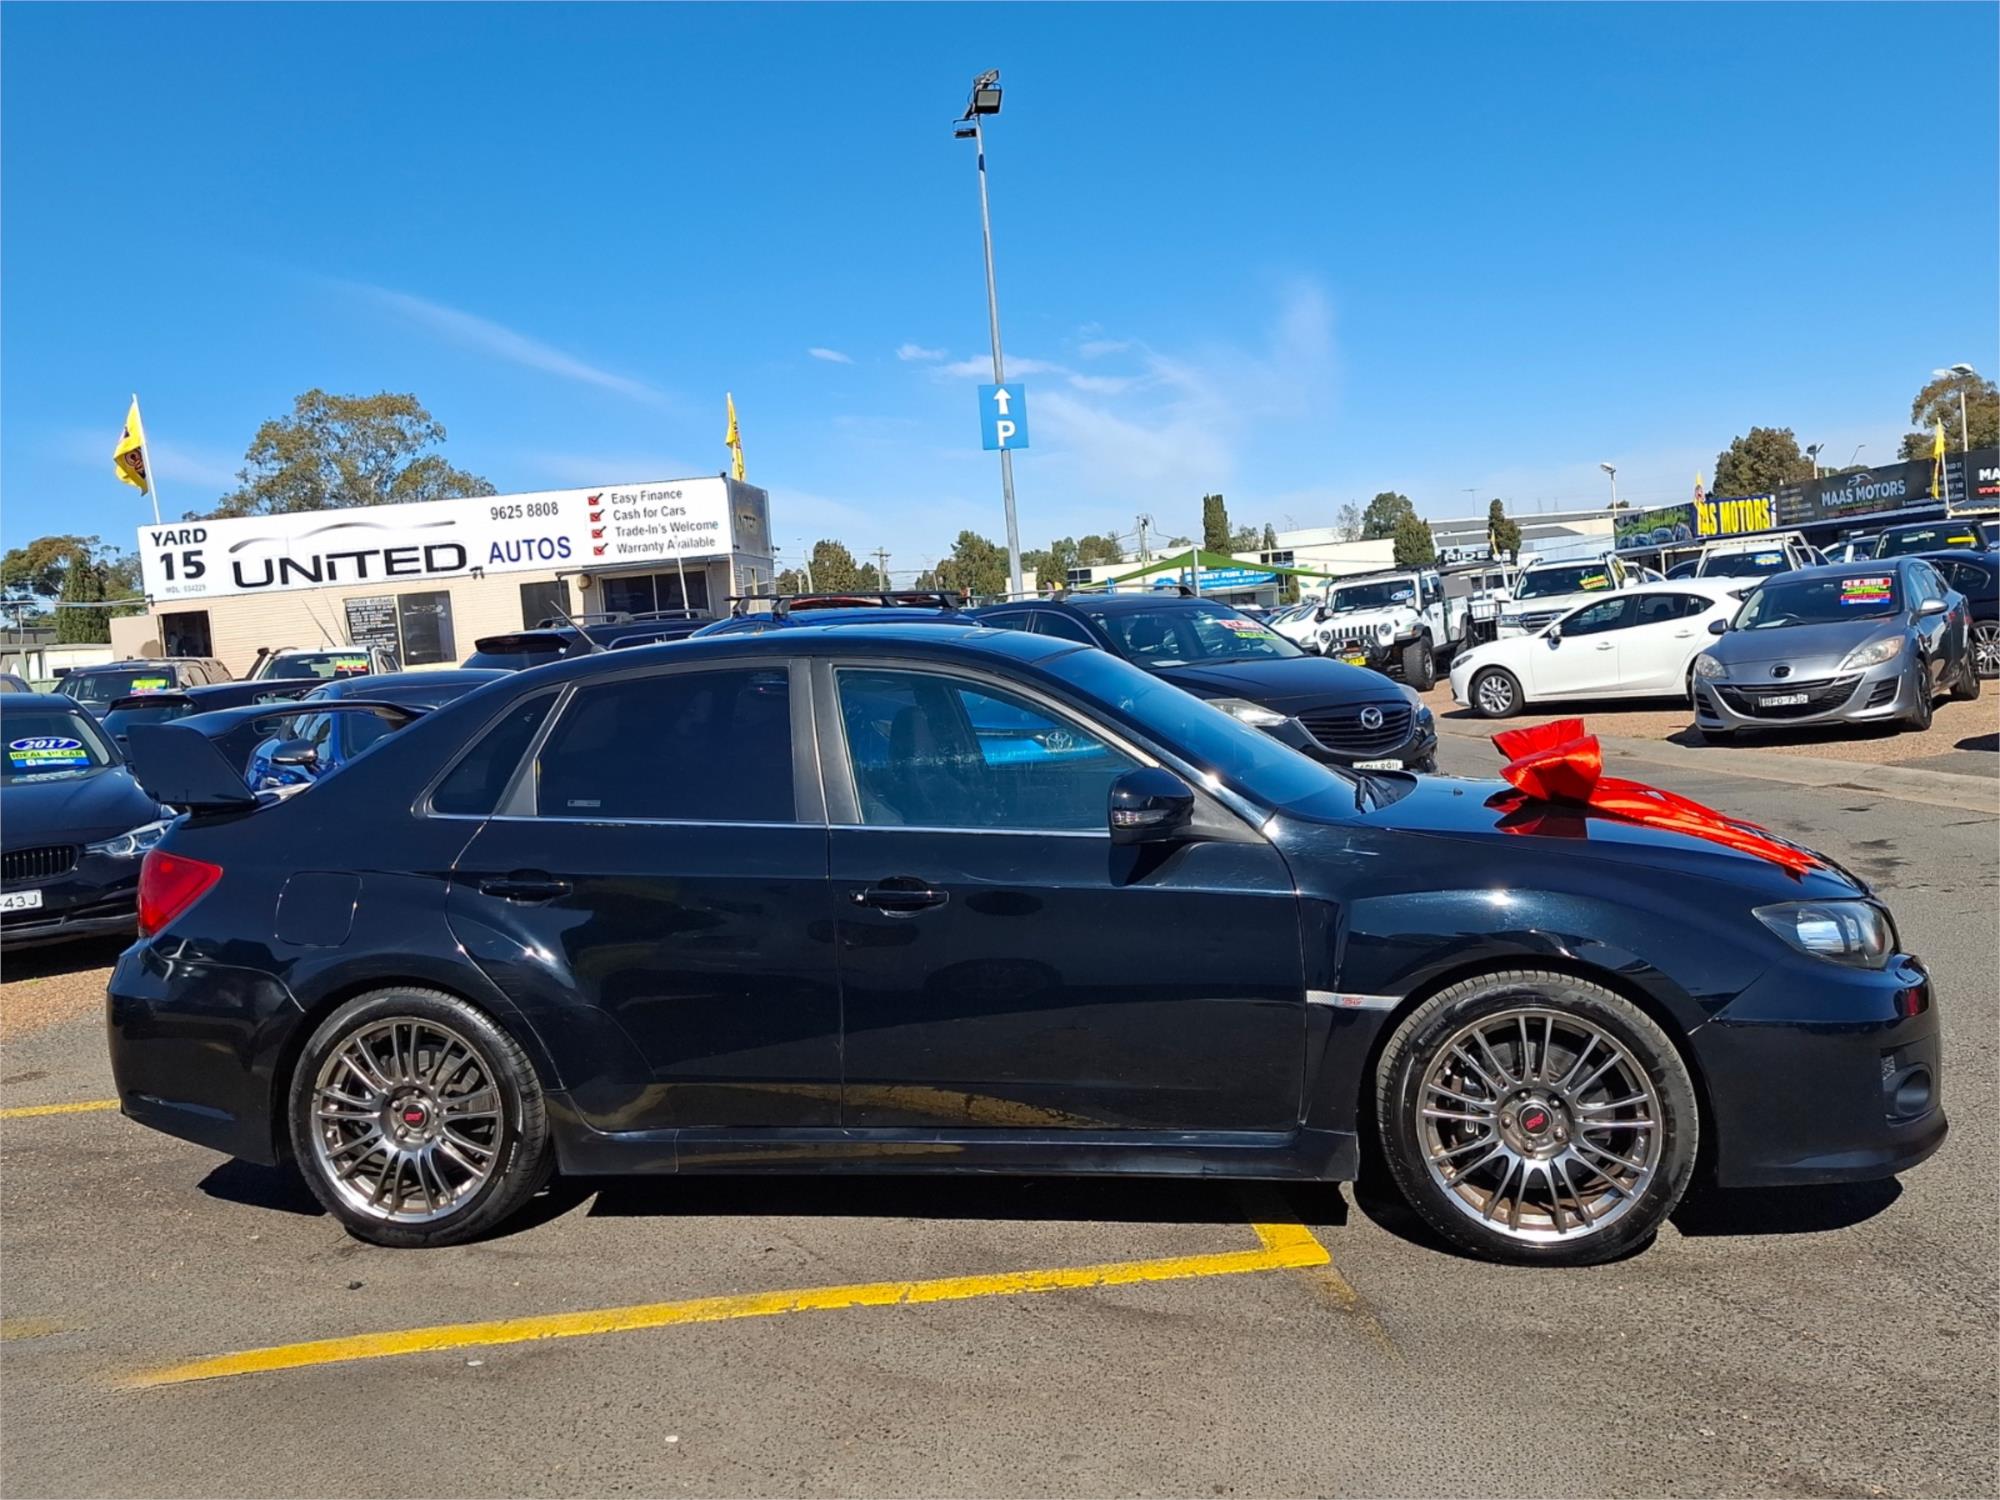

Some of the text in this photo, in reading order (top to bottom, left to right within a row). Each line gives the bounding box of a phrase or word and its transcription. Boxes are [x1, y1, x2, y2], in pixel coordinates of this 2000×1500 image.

[997, 420, 1016, 447] P
[611, 489, 682, 505] Easy Finance
[1821, 488, 1854, 507] MAAS
[1856, 479, 1906, 500] MOTORS
[490, 501, 559, 520] 9625 8808
[613, 505, 686, 521] Cash for Cars
[1719, 497, 1771, 534] MOTORS
[151, 528, 207, 547] YARD
[615, 519, 719, 538] Trade-In's Welcome
[489, 536, 572, 564] AUTOS
[617, 540, 660, 555] Warranty
[160, 550, 206, 581] 15
[232, 543, 467, 588] UNITED
[25, 739, 70, 749] 2017
